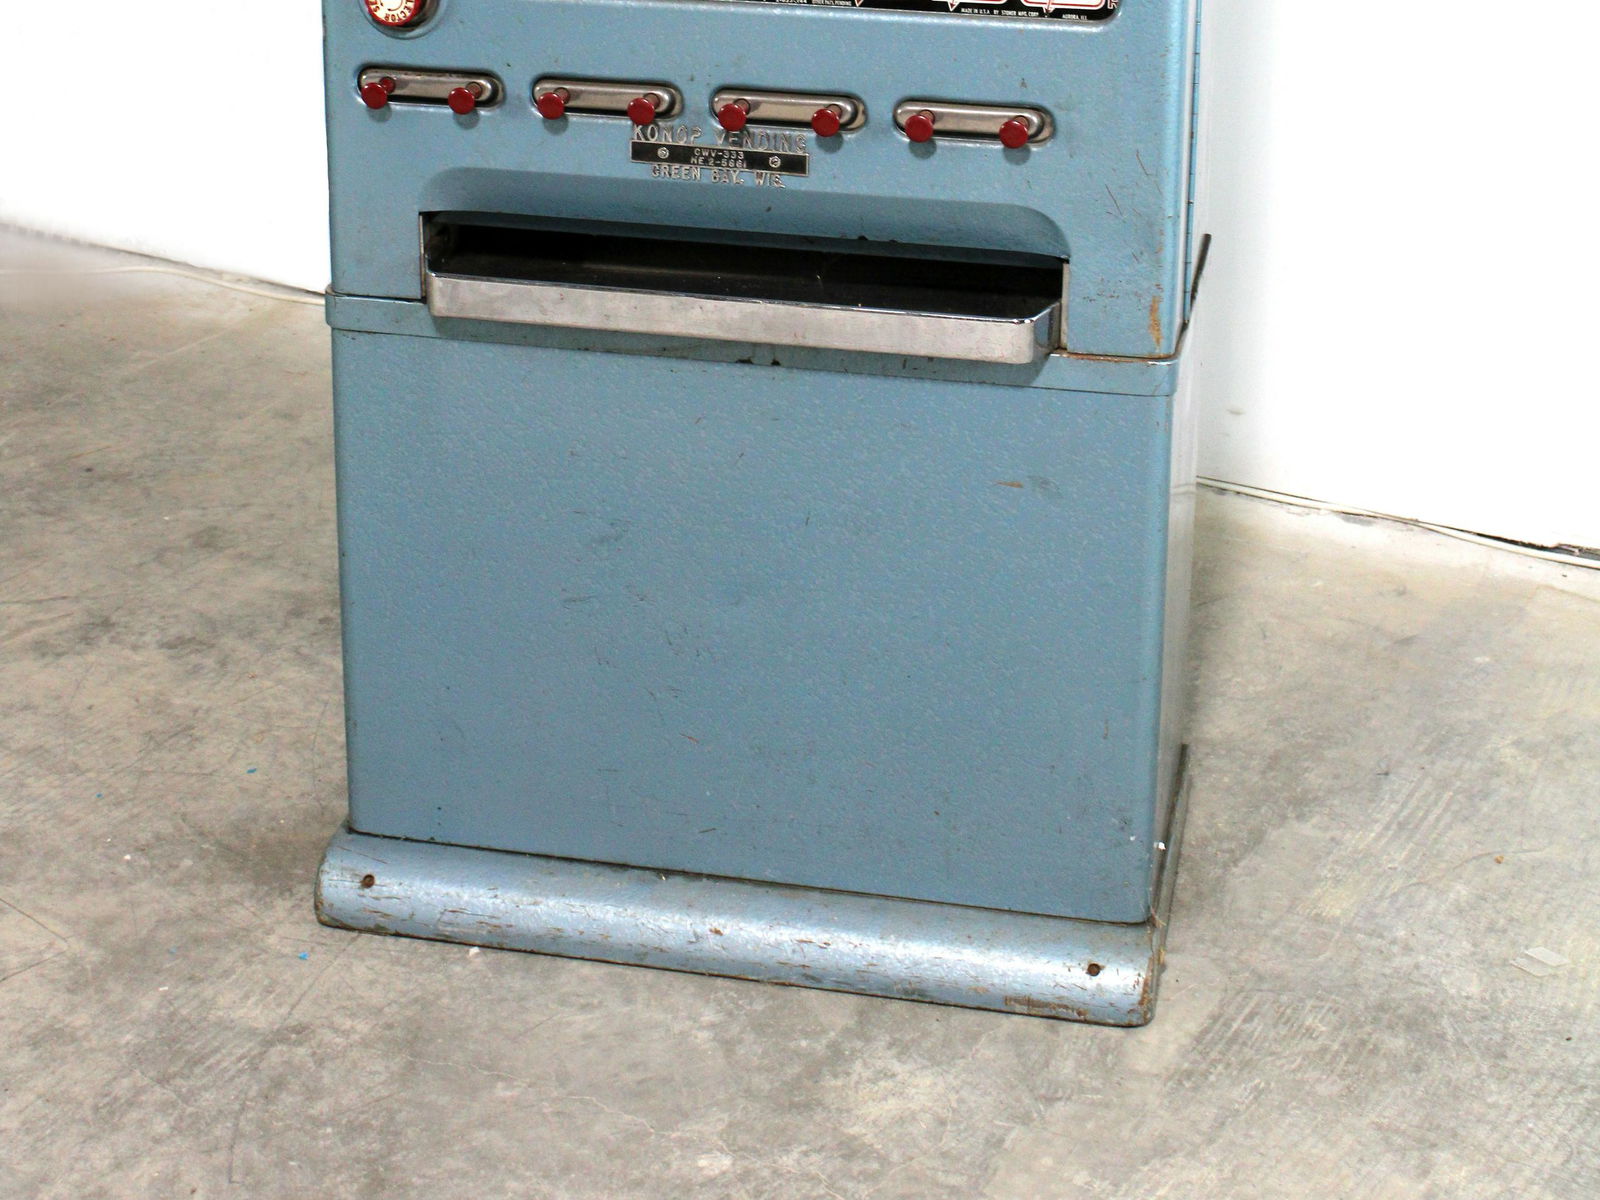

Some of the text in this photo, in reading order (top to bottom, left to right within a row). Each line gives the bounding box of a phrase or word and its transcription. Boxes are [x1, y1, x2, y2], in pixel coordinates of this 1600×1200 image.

[634, 124, 806, 154] KONOP VENDING
[651, 164, 701, 181] GREEN
